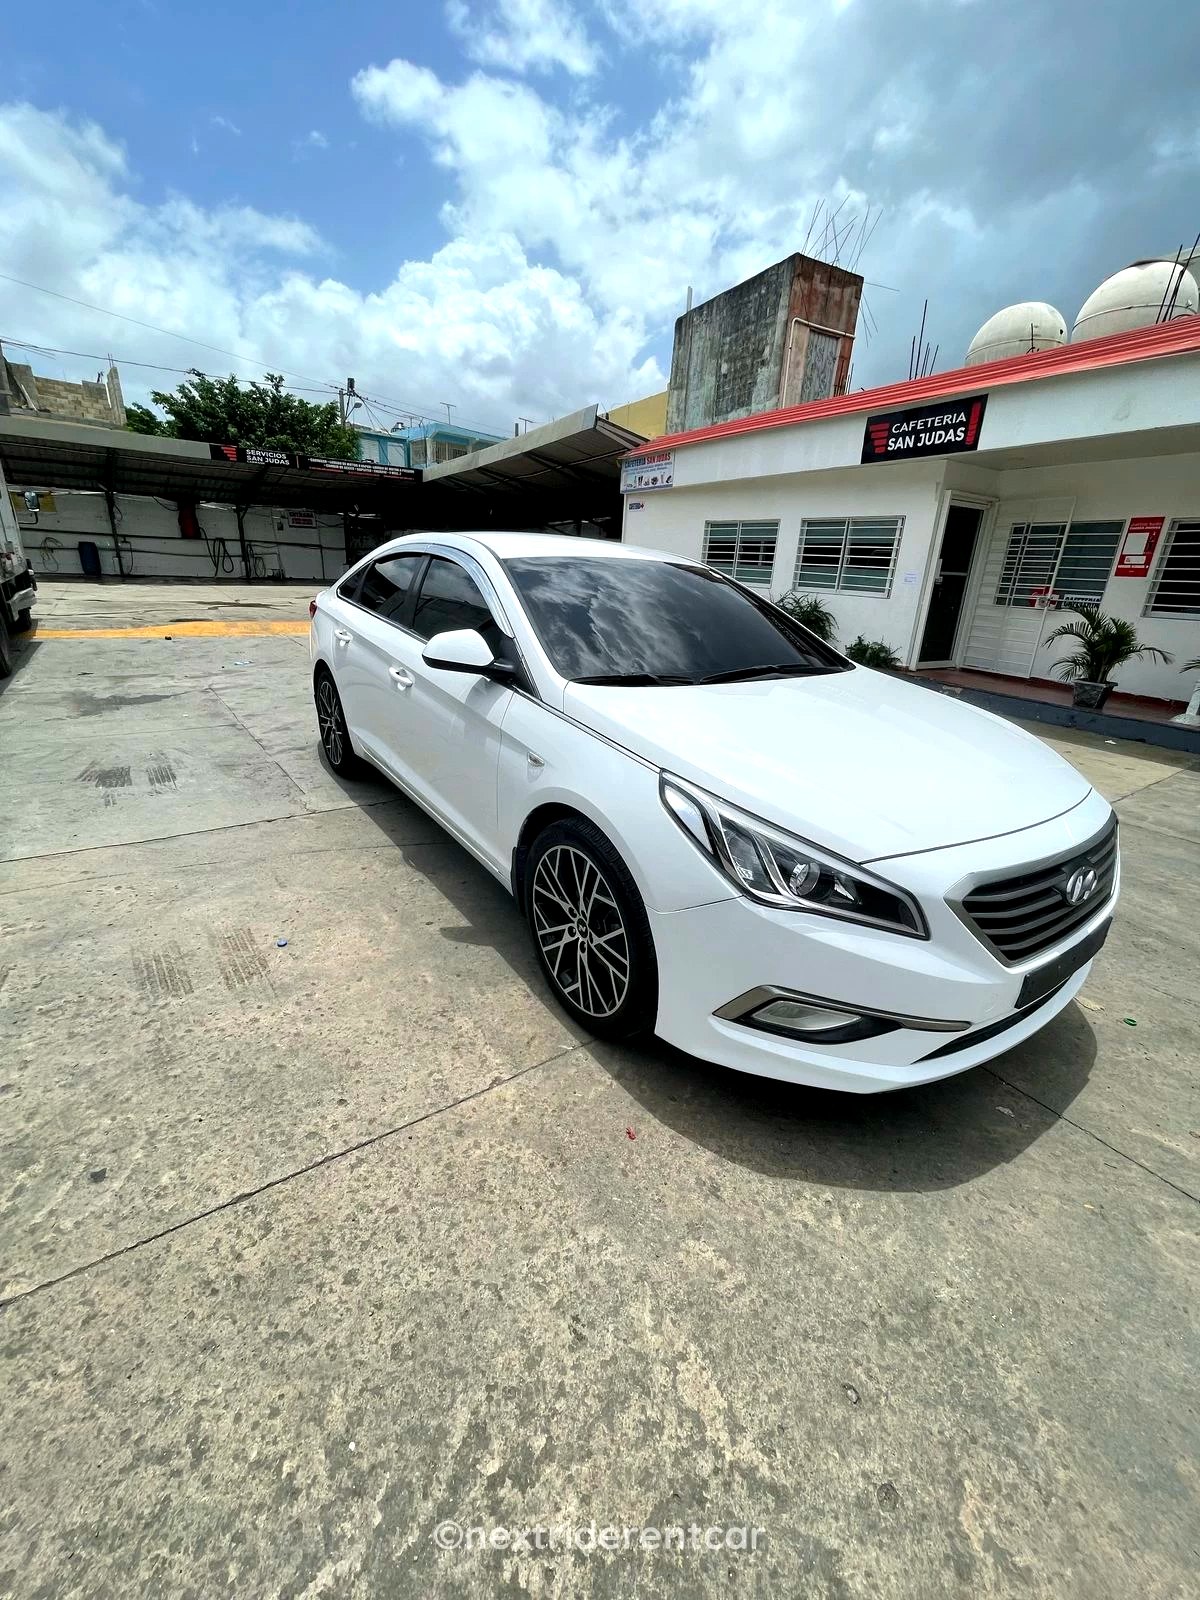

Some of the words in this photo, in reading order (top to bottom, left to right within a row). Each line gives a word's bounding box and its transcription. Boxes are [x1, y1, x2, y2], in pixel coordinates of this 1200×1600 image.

[892, 412, 966, 433] CAFETERIA
[887, 434, 915, 451] SAN
[917, 426, 966, 447] JUDAS
[246, 449, 286, 460] SERVICIOS
[647, 456, 656, 464] SAN
[264, 457, 290, 466] JUDAS
